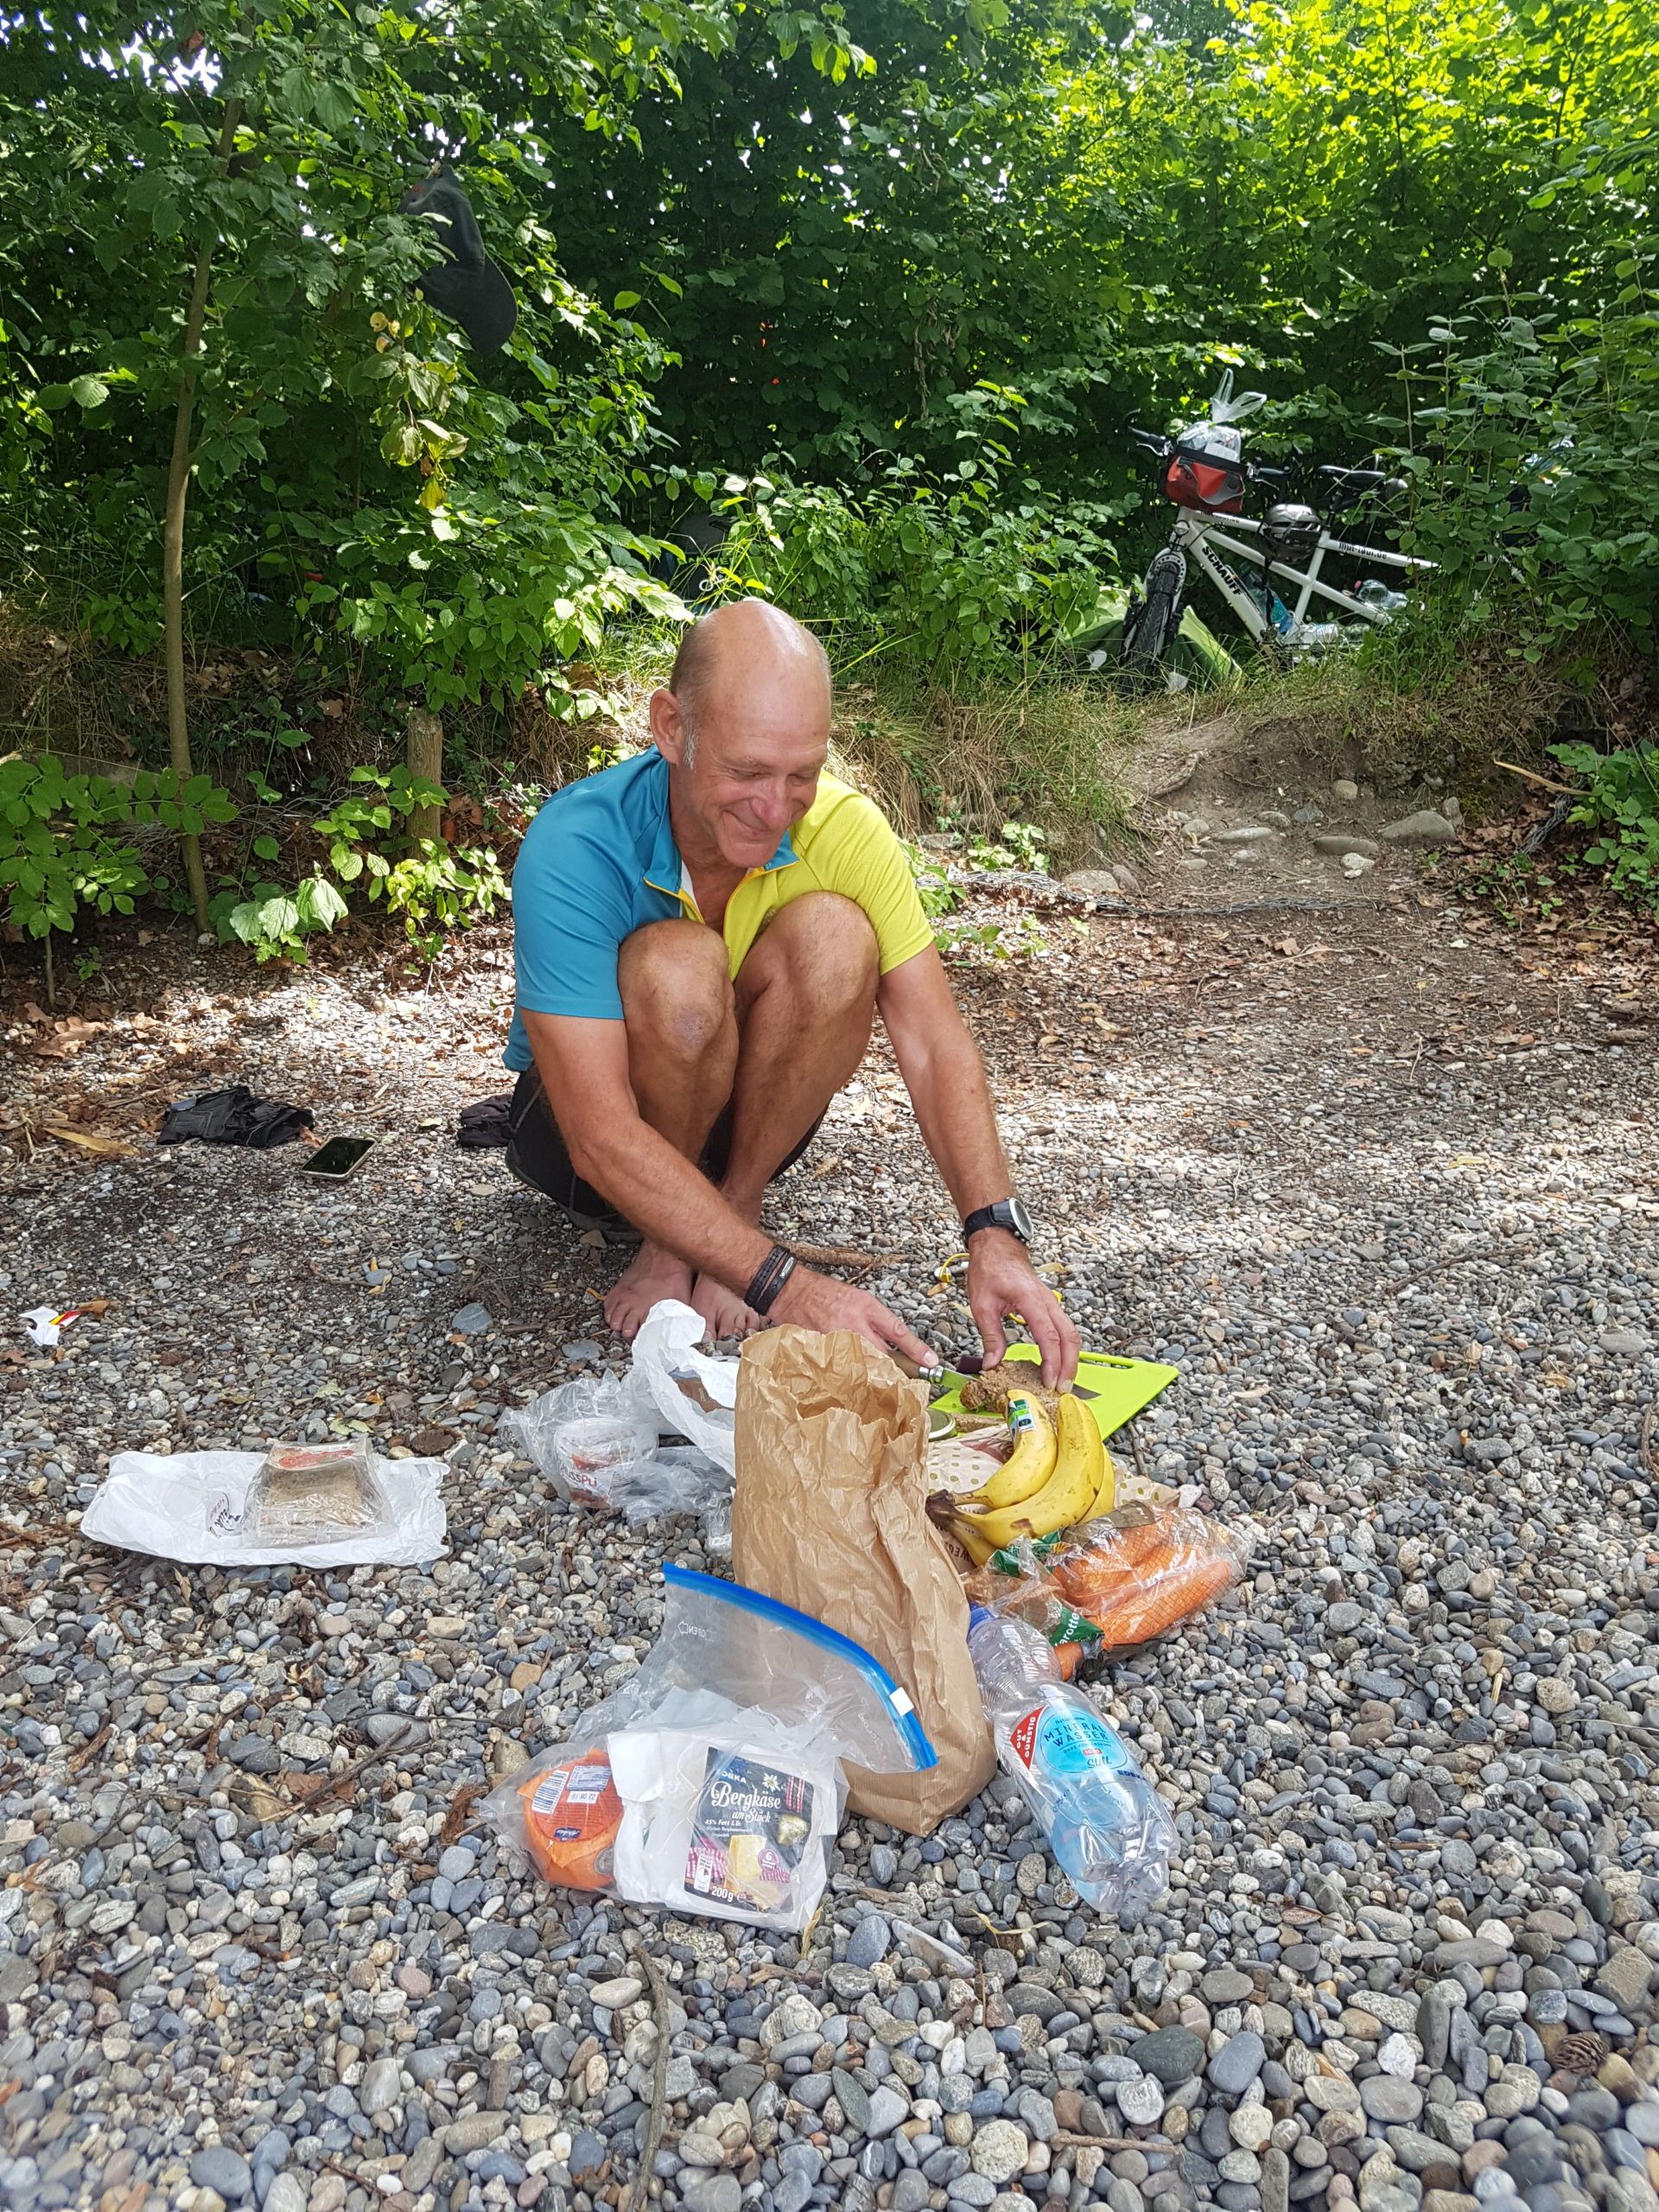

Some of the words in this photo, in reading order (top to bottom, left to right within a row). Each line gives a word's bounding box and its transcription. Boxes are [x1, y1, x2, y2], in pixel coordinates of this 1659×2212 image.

[1201, 545, 1242, 595] SCHAUFF
[1044, 1721, 1106, 1742] MINERAL
[1052, 1731, 1108, 1747] WASSER
[710, 1781, 782, 1812] Bergkäse
